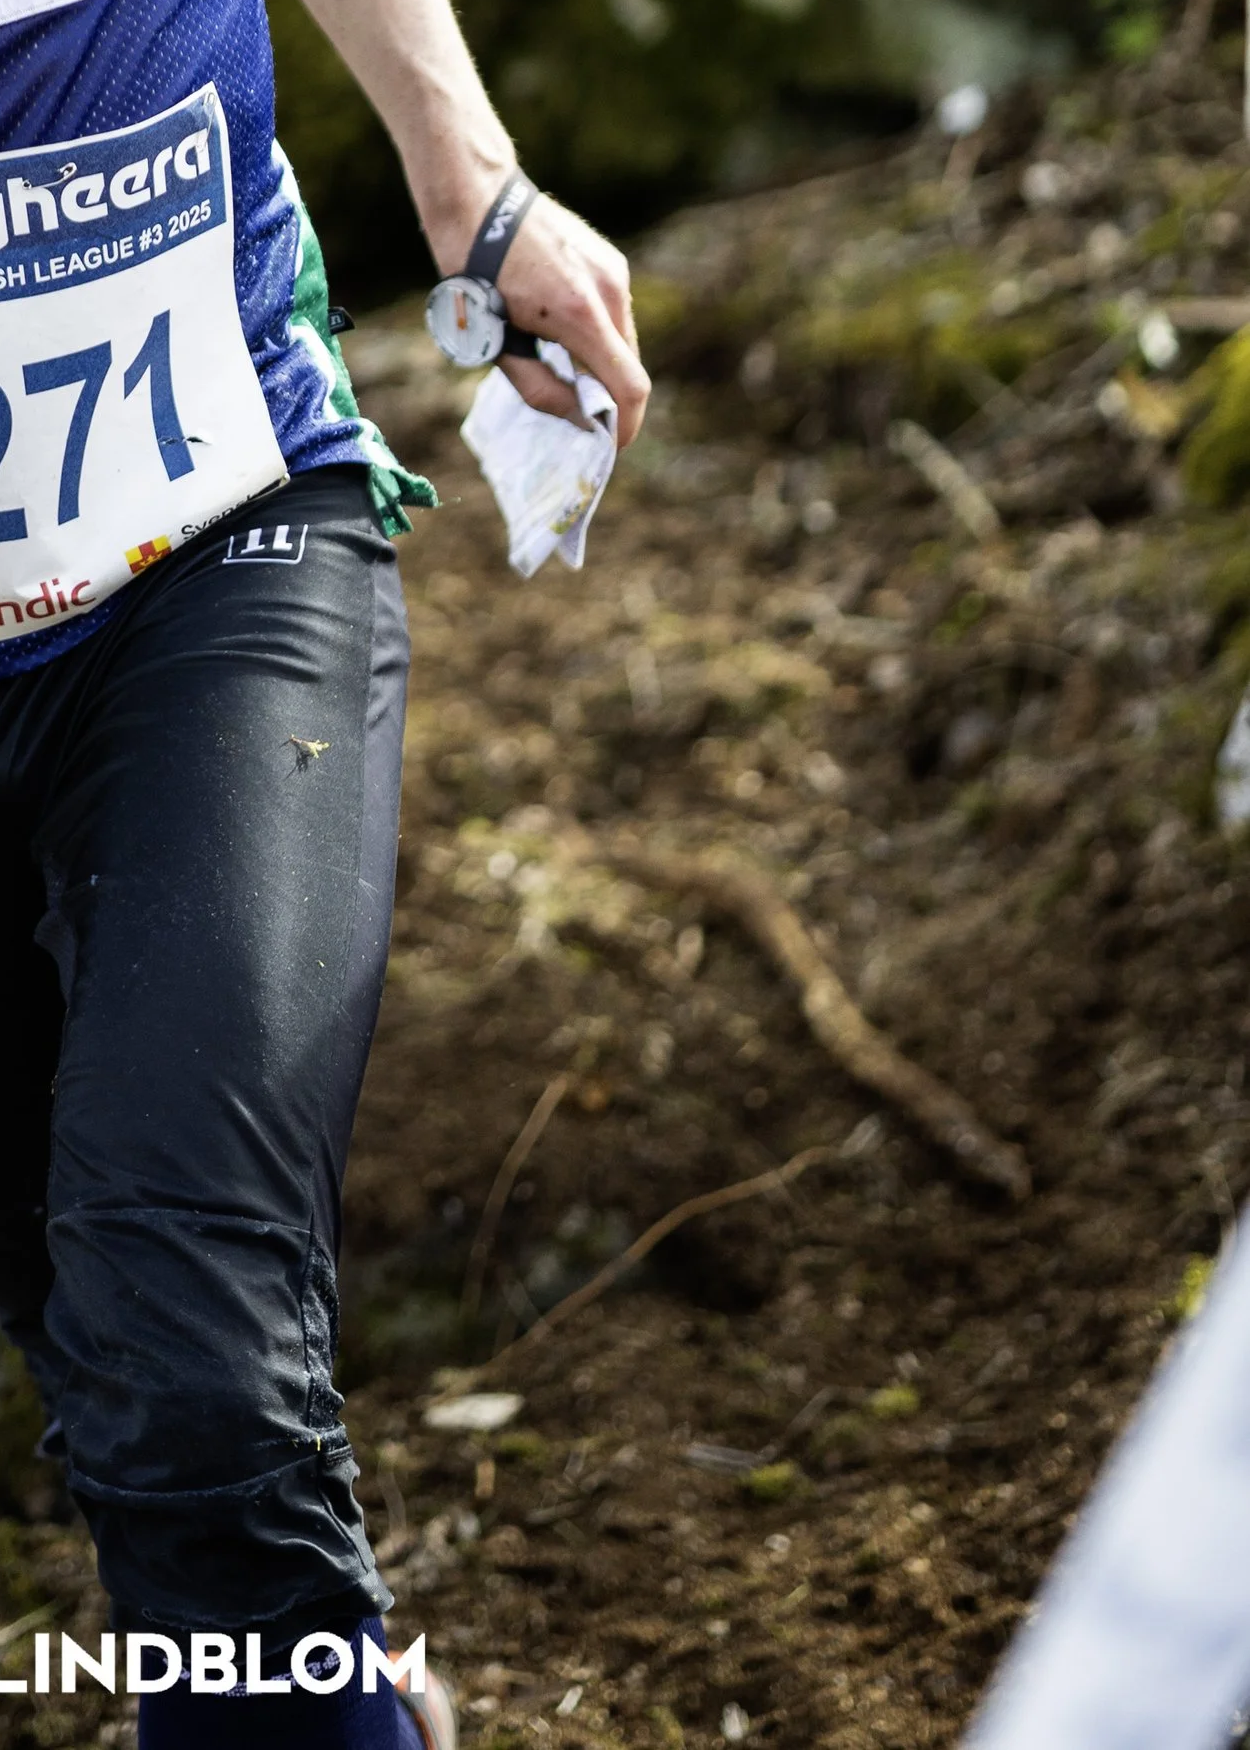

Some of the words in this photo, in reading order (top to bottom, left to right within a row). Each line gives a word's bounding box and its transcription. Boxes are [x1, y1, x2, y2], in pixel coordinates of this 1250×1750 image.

[34, 236, 135, 283] LEAGUE
[138, 225, 164, 252] #3
[168, 200, 212, 239] 2025
